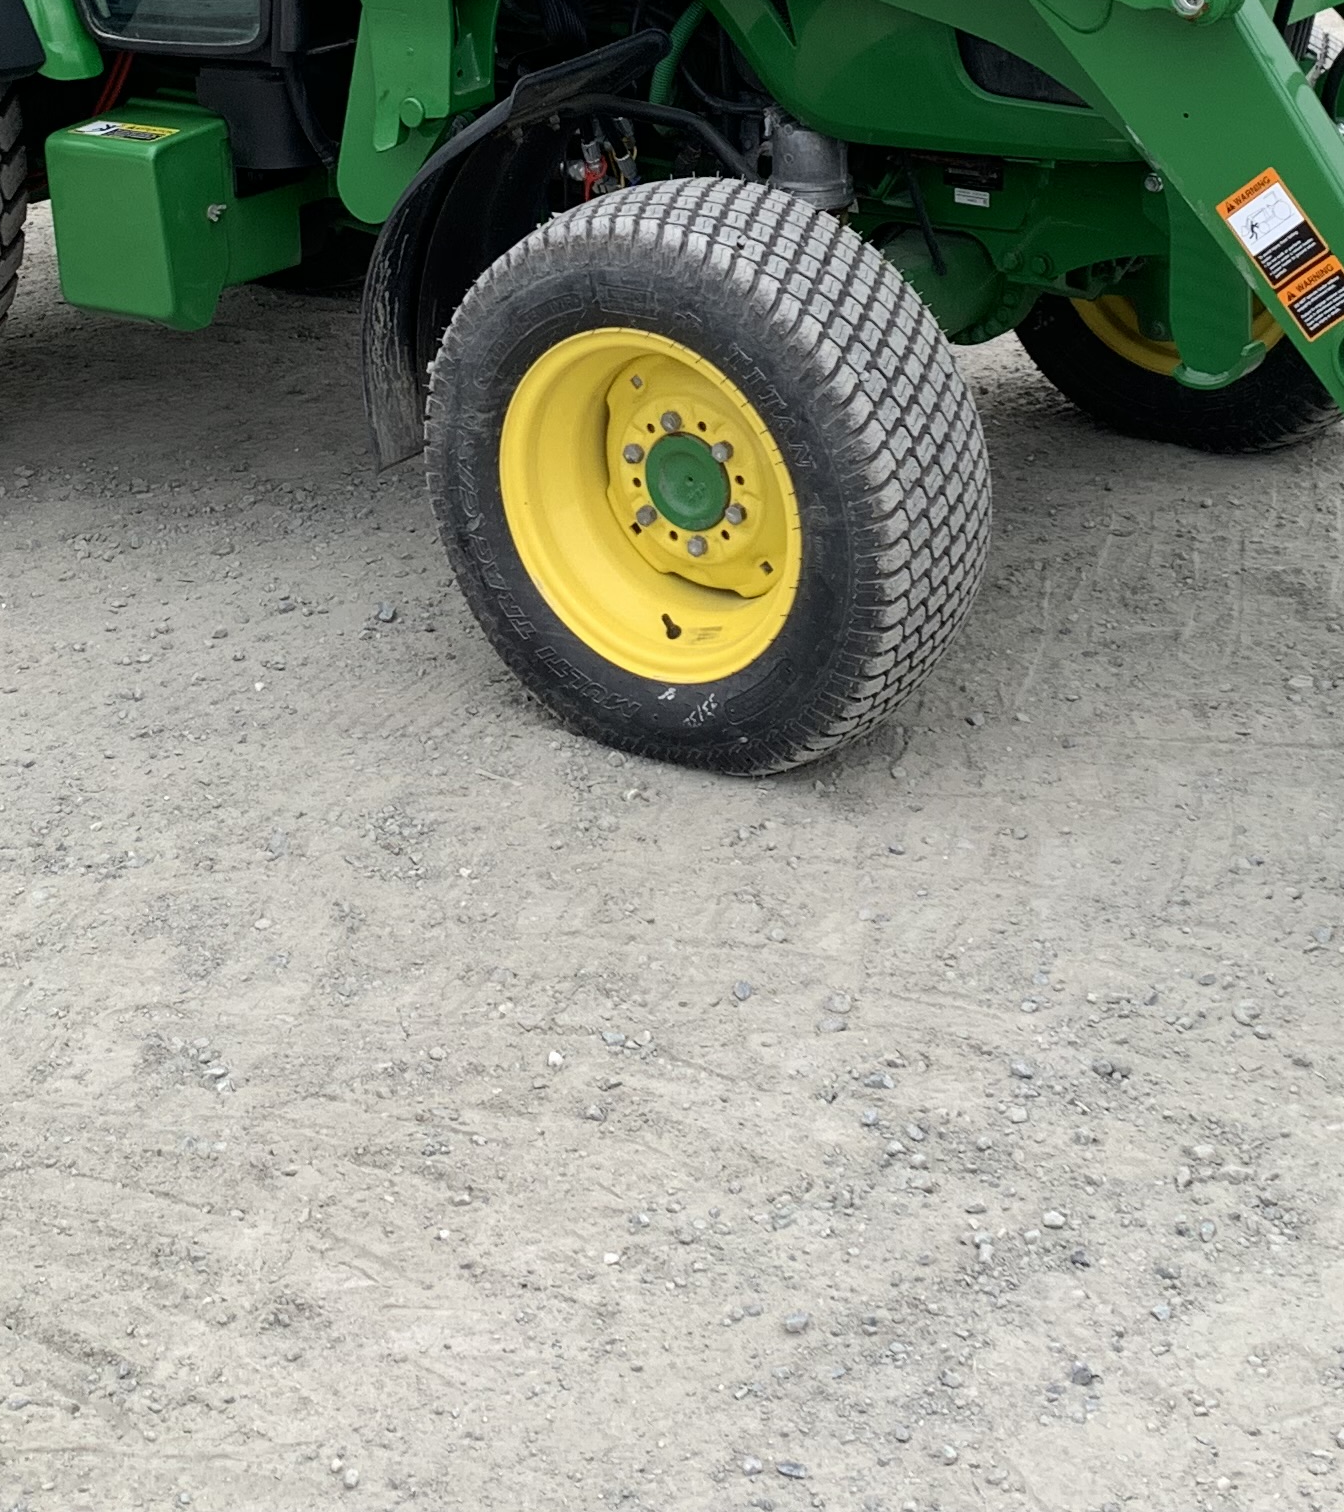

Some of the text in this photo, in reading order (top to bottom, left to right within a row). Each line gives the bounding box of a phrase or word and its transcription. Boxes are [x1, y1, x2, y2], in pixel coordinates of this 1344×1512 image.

[1233, 176, 1271, 207] WARNING
[1296, 263, 1334, 294] WARNING
[722, 342, 818, 470] TITAN
[467, 532, 537, 641] TRAC
[534, 645, 642, 718] MULTI
